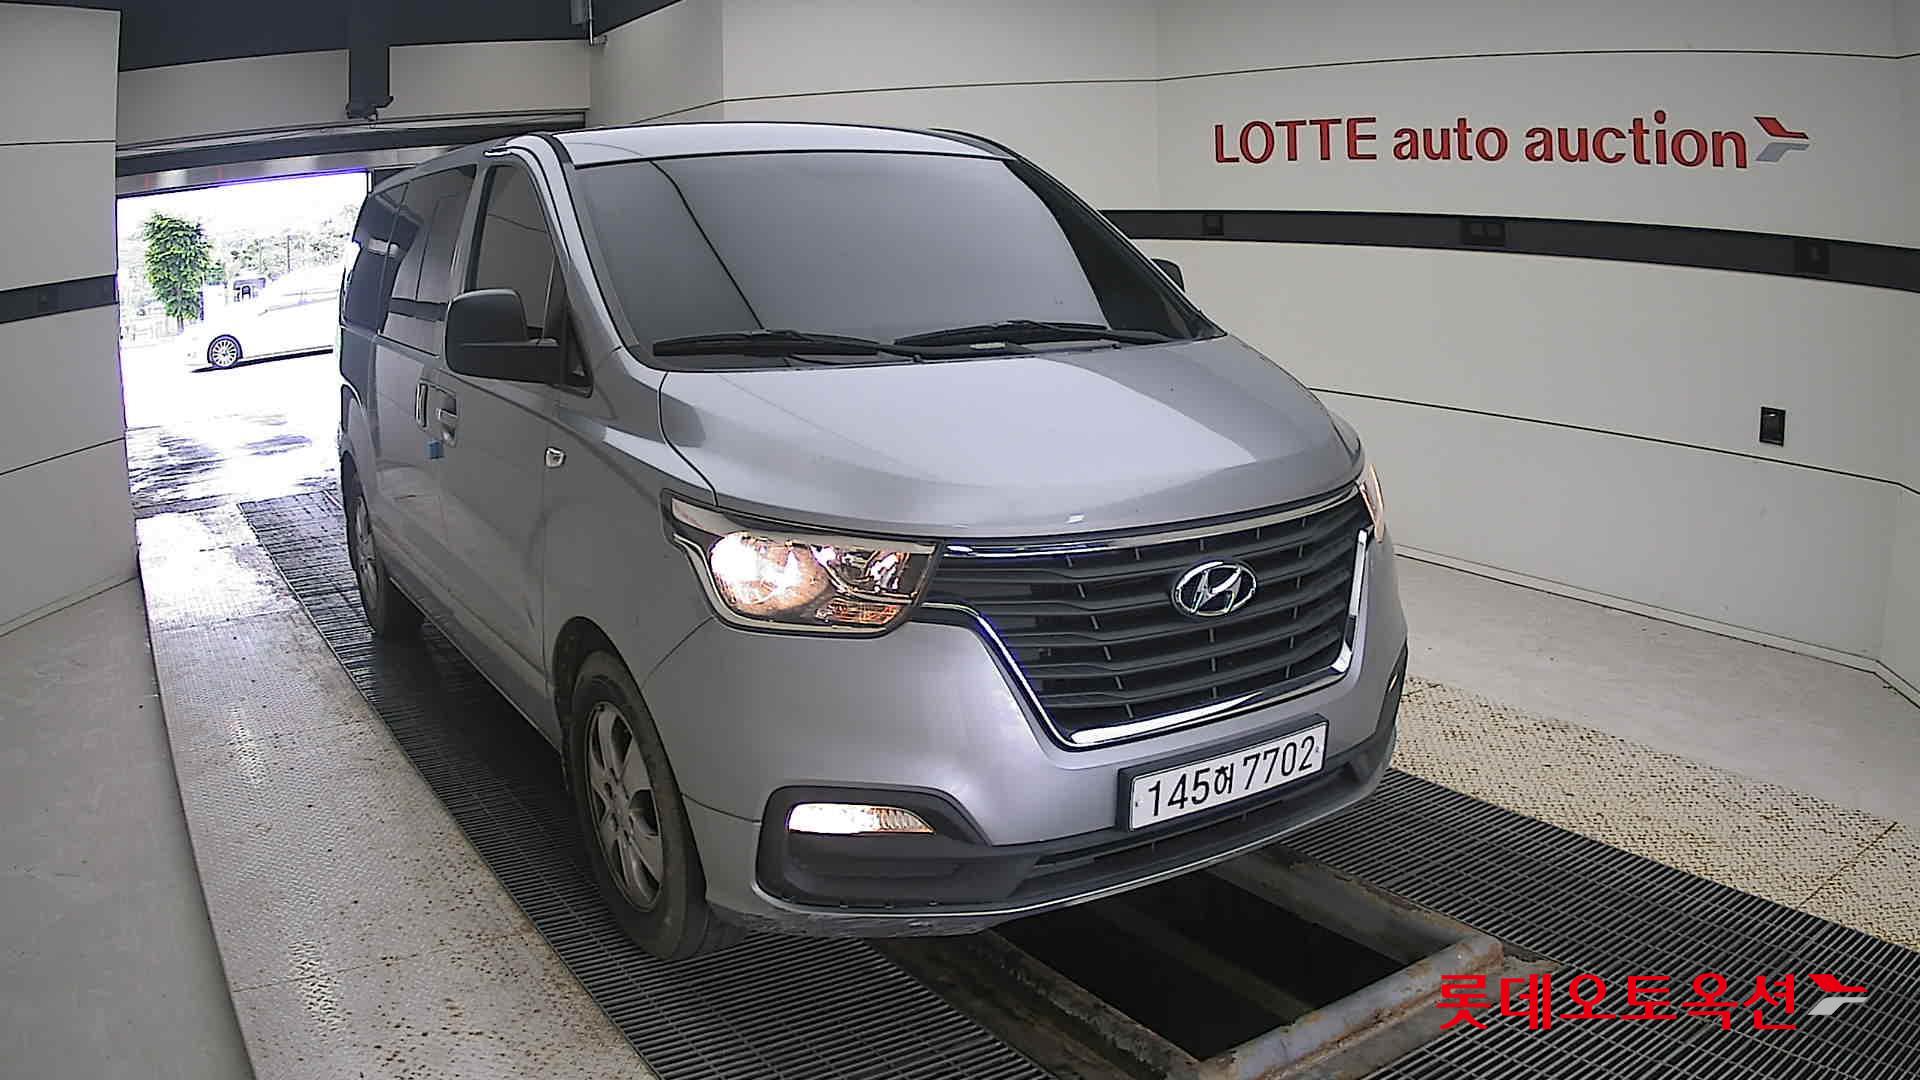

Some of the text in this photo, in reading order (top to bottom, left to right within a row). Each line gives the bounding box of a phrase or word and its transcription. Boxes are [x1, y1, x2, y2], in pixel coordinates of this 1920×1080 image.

[1214, 110, 1749, 169] LOTTE auto auction
